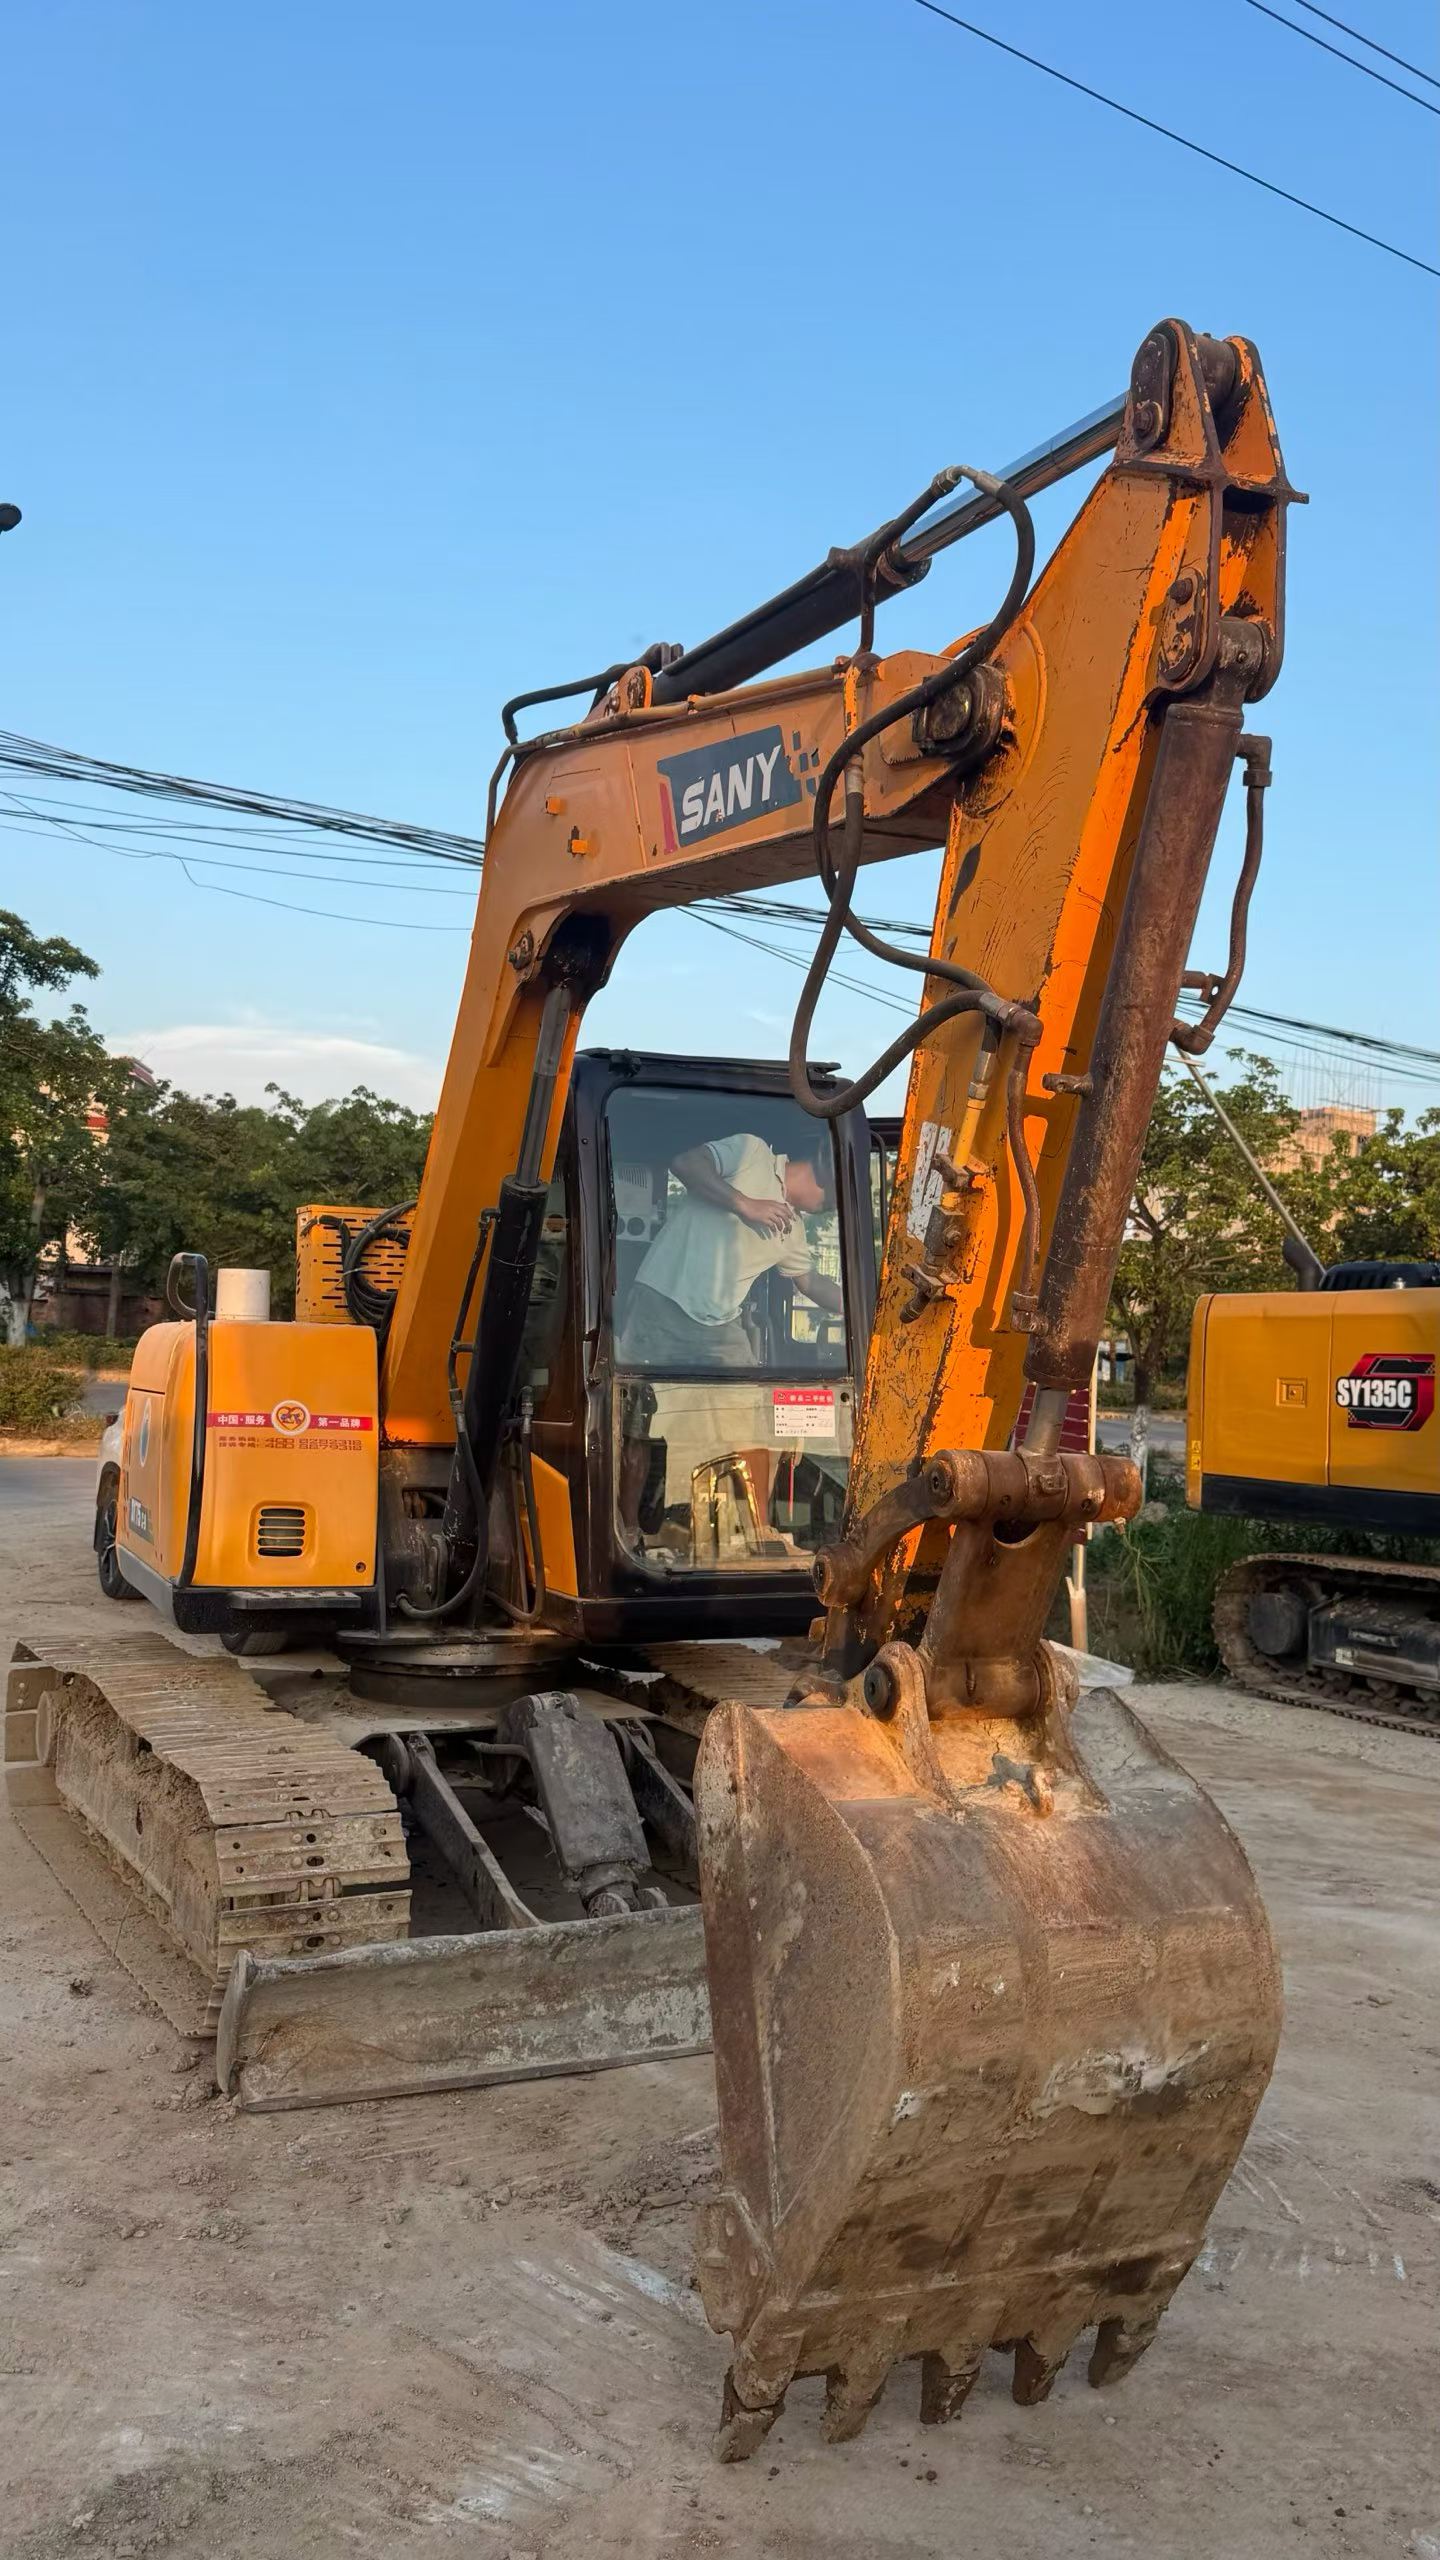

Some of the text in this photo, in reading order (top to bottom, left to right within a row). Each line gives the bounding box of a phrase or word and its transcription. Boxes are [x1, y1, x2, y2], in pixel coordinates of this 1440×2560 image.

[681, 744, 781, 834] SANY
[1337, 1378, 1412, 1408] SY135C
[217, 1414, 361, 1428] 中国·服务 第一品牌
